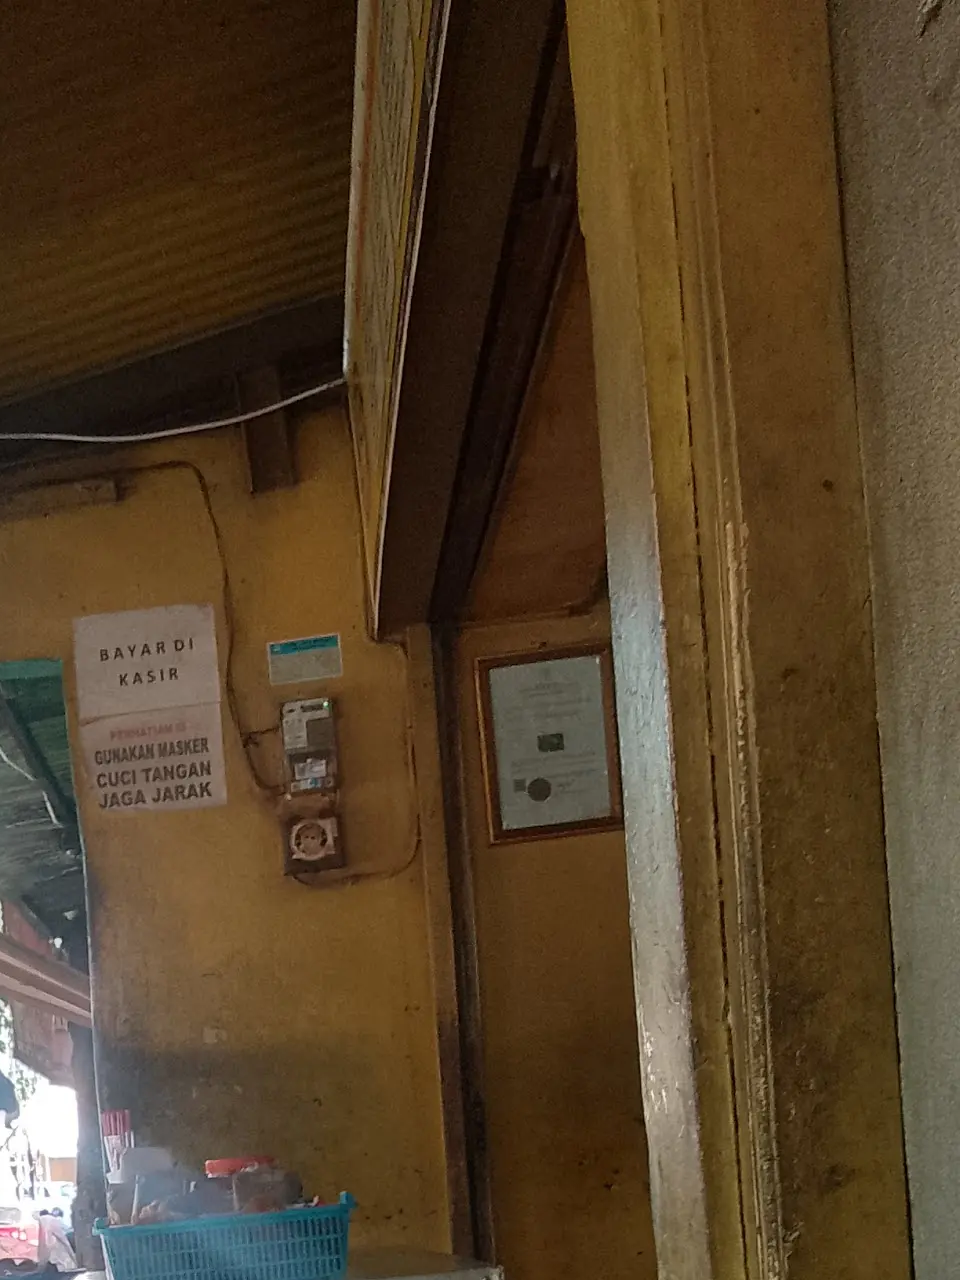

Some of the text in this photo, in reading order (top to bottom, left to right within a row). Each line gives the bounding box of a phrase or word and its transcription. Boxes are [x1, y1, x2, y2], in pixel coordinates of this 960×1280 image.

[100, 638, 193, 661] BAYAR DI
[120, 667, 178, 686] KASIR
[94, 737, 209, 765] GUNAKAN MASKER
[96, 760, 211, 788] CUCI TANGAN
[98, 781, 212, 808] JAGA JARAK
